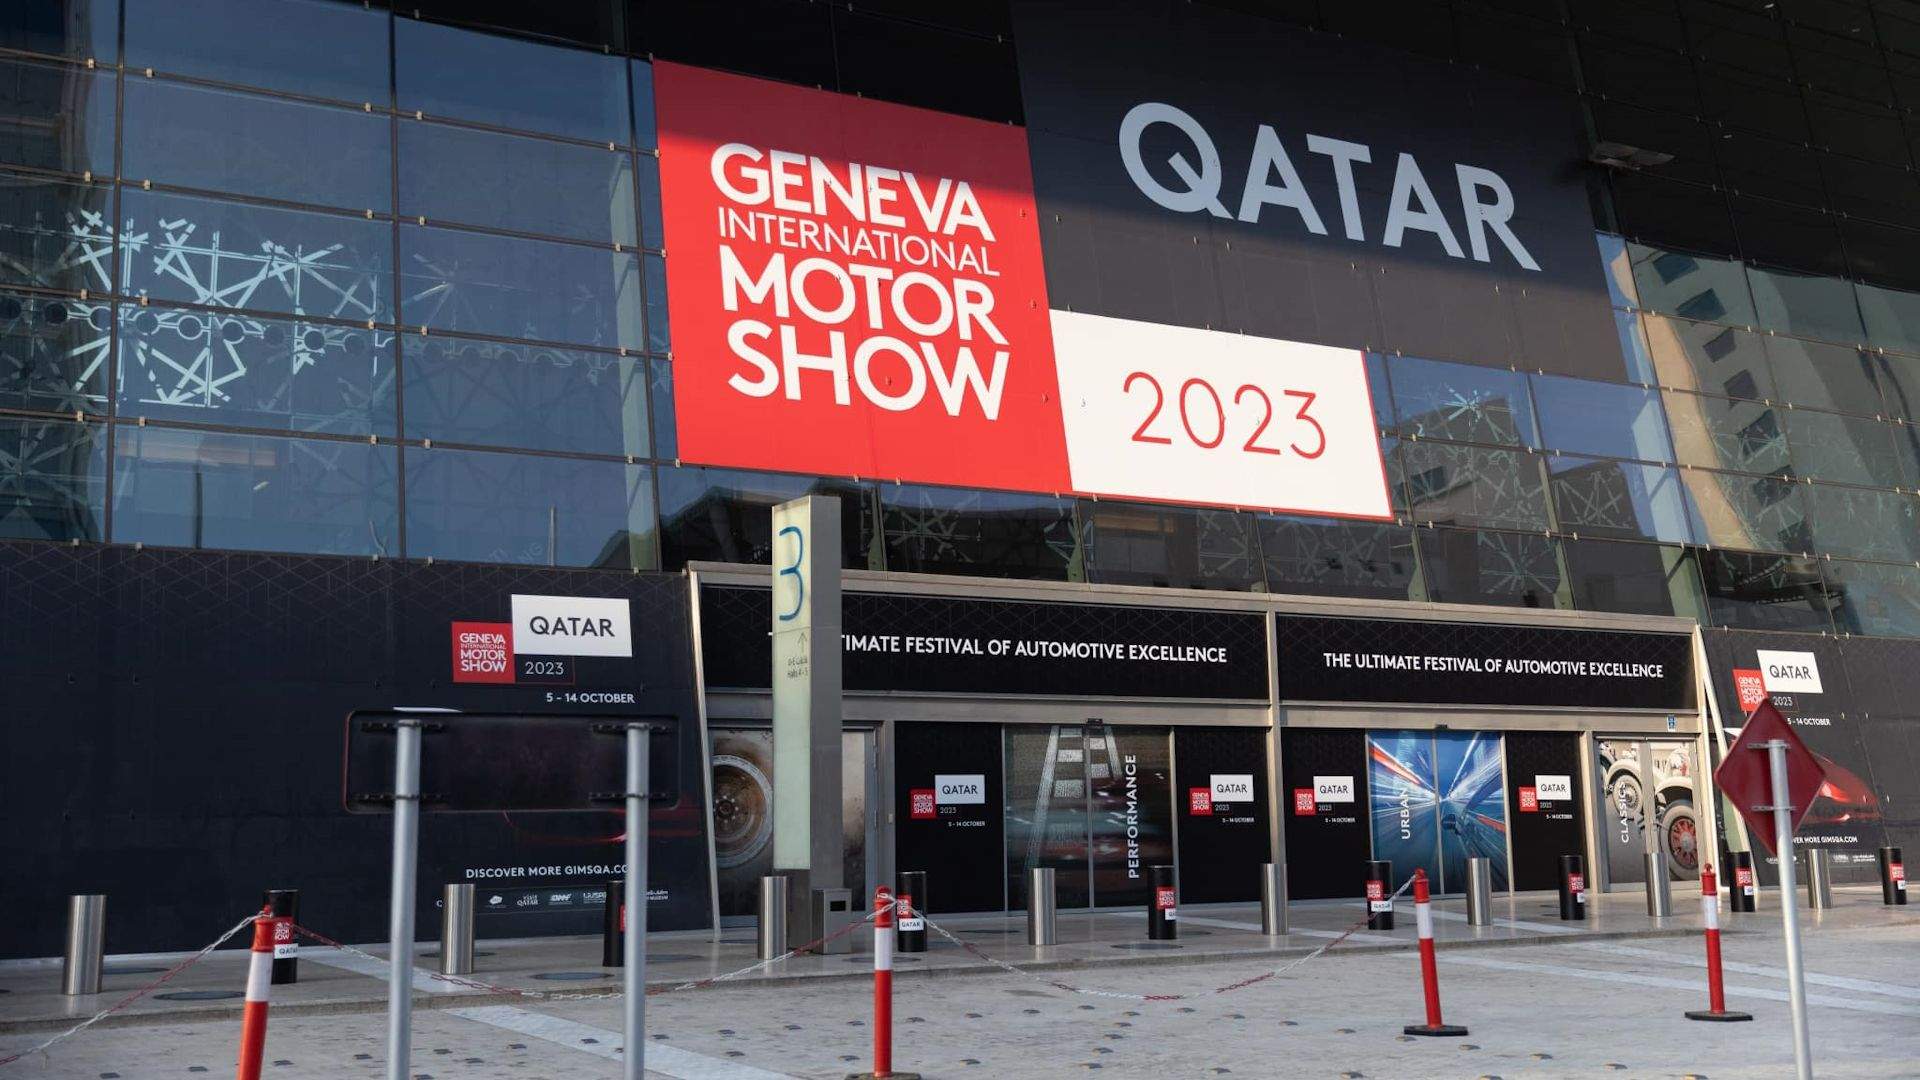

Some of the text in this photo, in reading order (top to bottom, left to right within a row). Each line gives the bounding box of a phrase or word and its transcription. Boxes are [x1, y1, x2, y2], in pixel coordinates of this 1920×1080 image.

[710, 143, 996, 242] GENEVA
[1118, 102, 1542, 272] QATAR
[718, 206, 1000, 277] INTERNATIONAL
[719, 245, 1010, 346] MOTOR
[727, 319, 1010, 421] SHOW
[1123, 371, 1326, 459] 2023
[779, 526, 804, 621] 3
[529, 615, 615, 637] QATAR
[459, 632, 506, 645] GENEVA
[460, 649, 507, 661] MOTOR
[841, 634, 1228, 663] IMATE FESTIVAL OF AUTOMOTIVE EXCELLENCE
[461, 660, 507, 673] SHOW
[525, 661, 565, 675] 2023
[1323, 652, 1664, 678] THE ULTIMATE FESTIVAL OF AUTOMOTIVE EXCELLENCE
[1769, 664, 1812, 680] QATAR
[546, 692, 553, 703] 5
[565, 693, 577, 703] 14
[579, 693, 636, 704] OCTOBER
[1772, 696, 1793, 707] 2023
[1803, 717, 1831, 726] OCTOBER
[942, 785, 978, 795] QATAR
[1216, 784, 1248, 793] QATAR
[1319, 785, 1349, 794] QATAR
[1540, 783, 1566, 792] QATAR
[1125, 754, 1140, 879] PERFORMANCE
[1400, 787, 1411, 840] URBAN
[466, 863, 629, 879] DISCOVER MORE GIMSQA.CO
